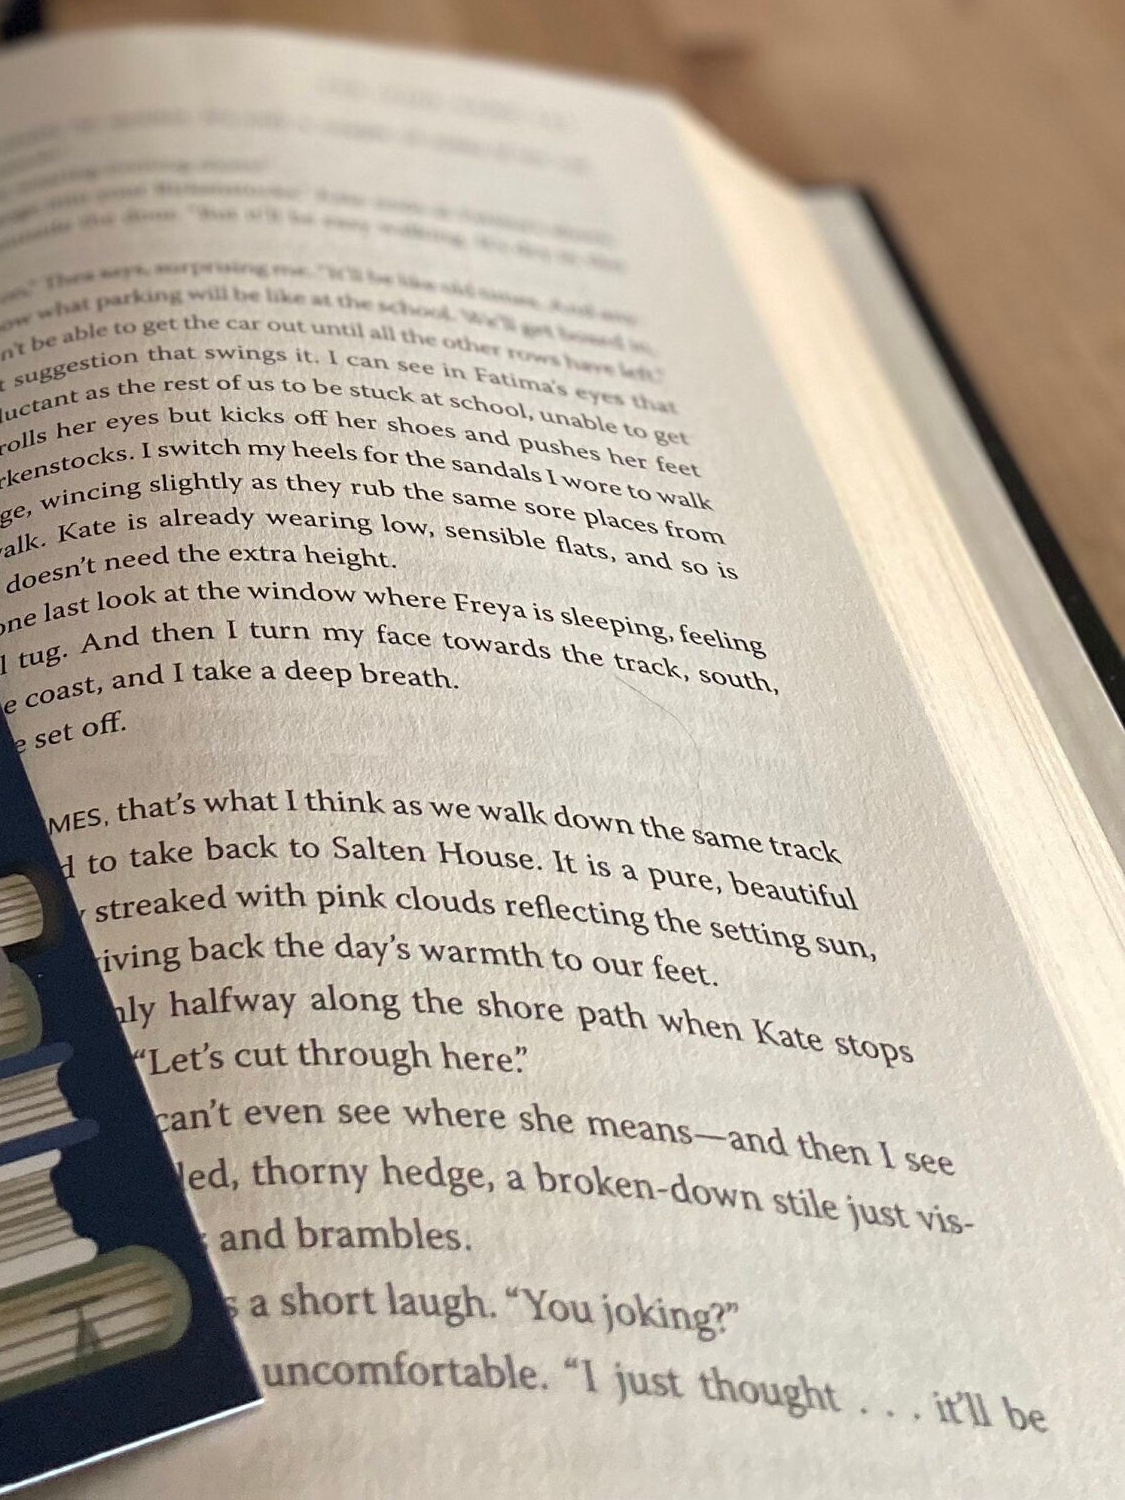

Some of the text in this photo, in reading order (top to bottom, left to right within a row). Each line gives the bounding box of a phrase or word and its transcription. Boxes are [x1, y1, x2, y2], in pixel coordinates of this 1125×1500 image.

[14, 350, 139, 388] suggestion
[148, 345, 201, 362] that
[205, 345, 287, 366] swings
[296, 347, 319, 363] it.
[329, 349, 339, 366] I
[346, 353, 390, 370] can
[397, 360, 434, 375] see
[443, 363, 467, 380] in
[575, 388, 625, 408] eyes
[632, 394, 678, 415] that
[105, 545, 169, 571] need
[178, 543, 220, 563] the
[229, 544, 297, 563] extra
[304, 544, 396, 572] height.
[26, 659, 458, 708] coast, and I take a deep breath.
[36, 709, 126, 749] set off.
[203, 789, 278, 812] what
[285, 789, 297, 812] I
[304, 789, 385, 814] think
[393, 799, 422, 816] as
[429, 802, 471, 820] we
[477, 801, 547, 826] walk
[554, 804, 635, 835] down
[640, 815, 685, 842] the
[692, 829, 763, 853] same
[769, 837, 842, 864] track
[88, 834, 859, 911] to take back to Salten House. It is a pure, beautiful
[235, 1043, 288, 1068] cut
[297, 1038, 431, 1077] through
[245, 1104, 325, 1126] even
[338, 1104, 390, 1125] see
[403, 1097, 506, 1130] where
[519, 1102, 574, 1134] she
[797, 1130, 871, 1167] then
[879, 1141, 895, 1170] I
[905, 1152, 955, 1176] see
[219, 1217, 472, 1252] and brambles.
[250, 1294, 270, 1318] a
[280, 1281, 377, 1317] short
[386, 1281, 497, 1329] laugh.
